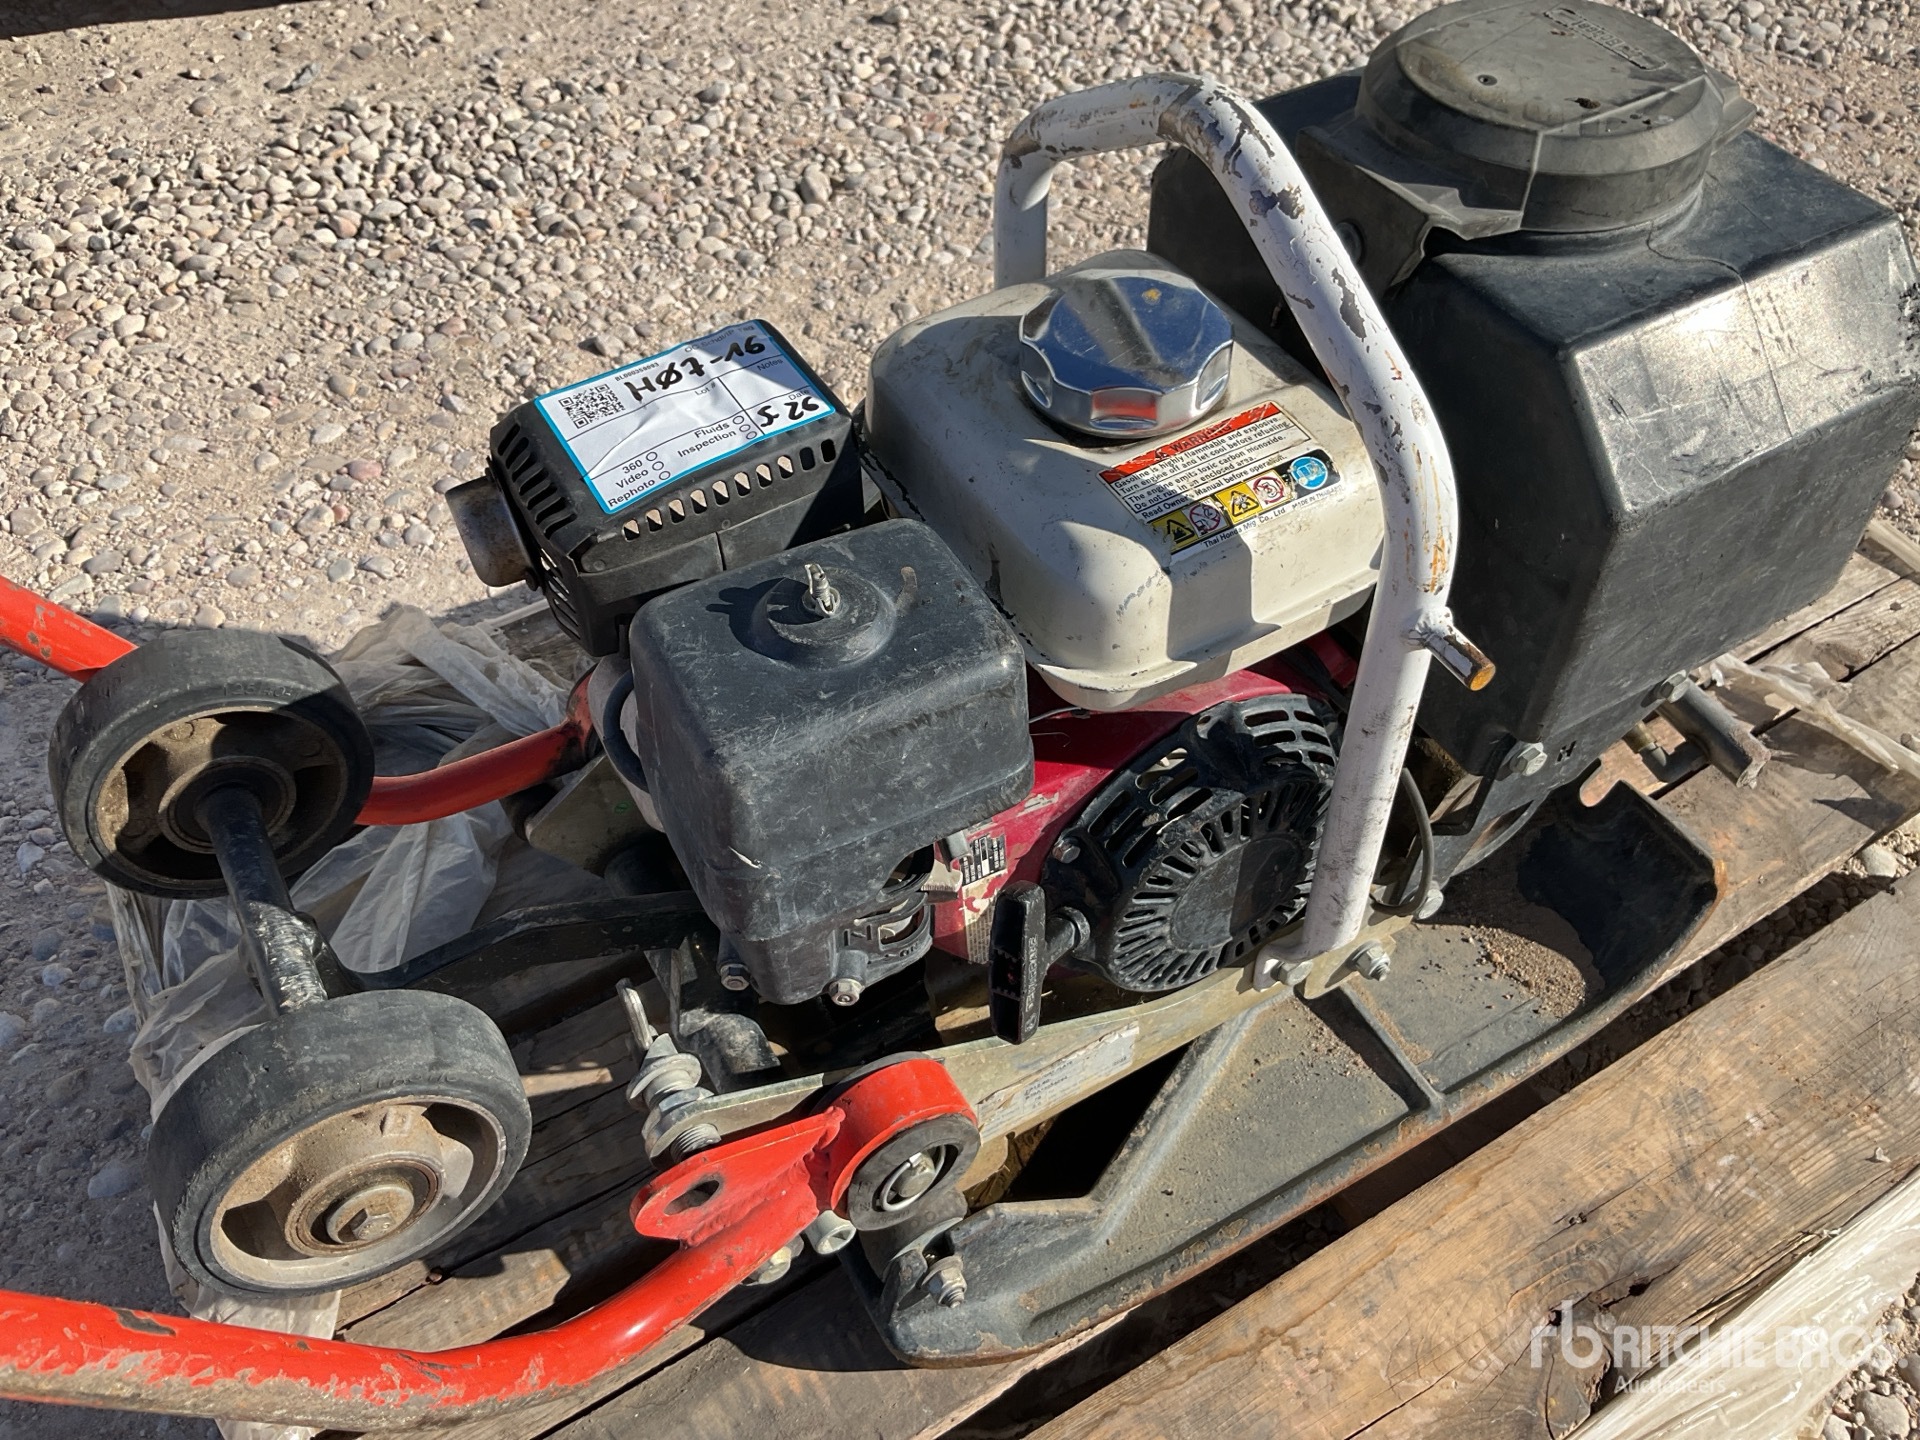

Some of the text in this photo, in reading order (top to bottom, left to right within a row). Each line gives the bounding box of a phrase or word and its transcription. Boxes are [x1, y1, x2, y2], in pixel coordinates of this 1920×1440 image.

[756, 357, 784, 372] Notes
[694, 386, 710, 396] Lot
[788, 389, 810, 401] Date
[677, 429, 737, 458] Inspection
[693, 421, 730, 439] Fluids
[1170, 419, 1232, 452] WARNING
[622, 459, 643, 474] 360
[1114, 471, 1150, 489] Gasoline
[1160, 456, 1184, 471] highly
[1184, 437, 1226, 458] flammable
[1227, 431, 1242, 441] and
[1243, 417, 1281, 434] explosive.
[1120, 483, 1140, 495] Turn
[1141, 471, 1168, 484] engine
[1169, 464, 1181, 474] off
[1182, 459, 1197, 468] and
[1197, 452, 1210, 460] let
[1210, 446, 1227, 456] cool
[1227, 433, 1253, 448] before
[615, 468, 649, 489] Video
[1128, 435, 1287, 503] The engine emits toxic carbon monoxide.
[608, 478, 656, 507] Rephoto
[1134, 502, 1147, 511] Do
[1148, 496, 1162, 505] not
[1163, 489, 1178, 498] run
[1178, 483, 1187, 491] in
[1200, 463, 1235, 482] enclosed
[1141, 506, 1163, 519] Read
[1163, 493, 1195, 510] Owner's
[1194, 481, 1224, 496] Manual
[1224, 468, 1249, 484] before
[1203, 536, 1219, 548] Thai
[1220, 527, 1243, 542] Honda
